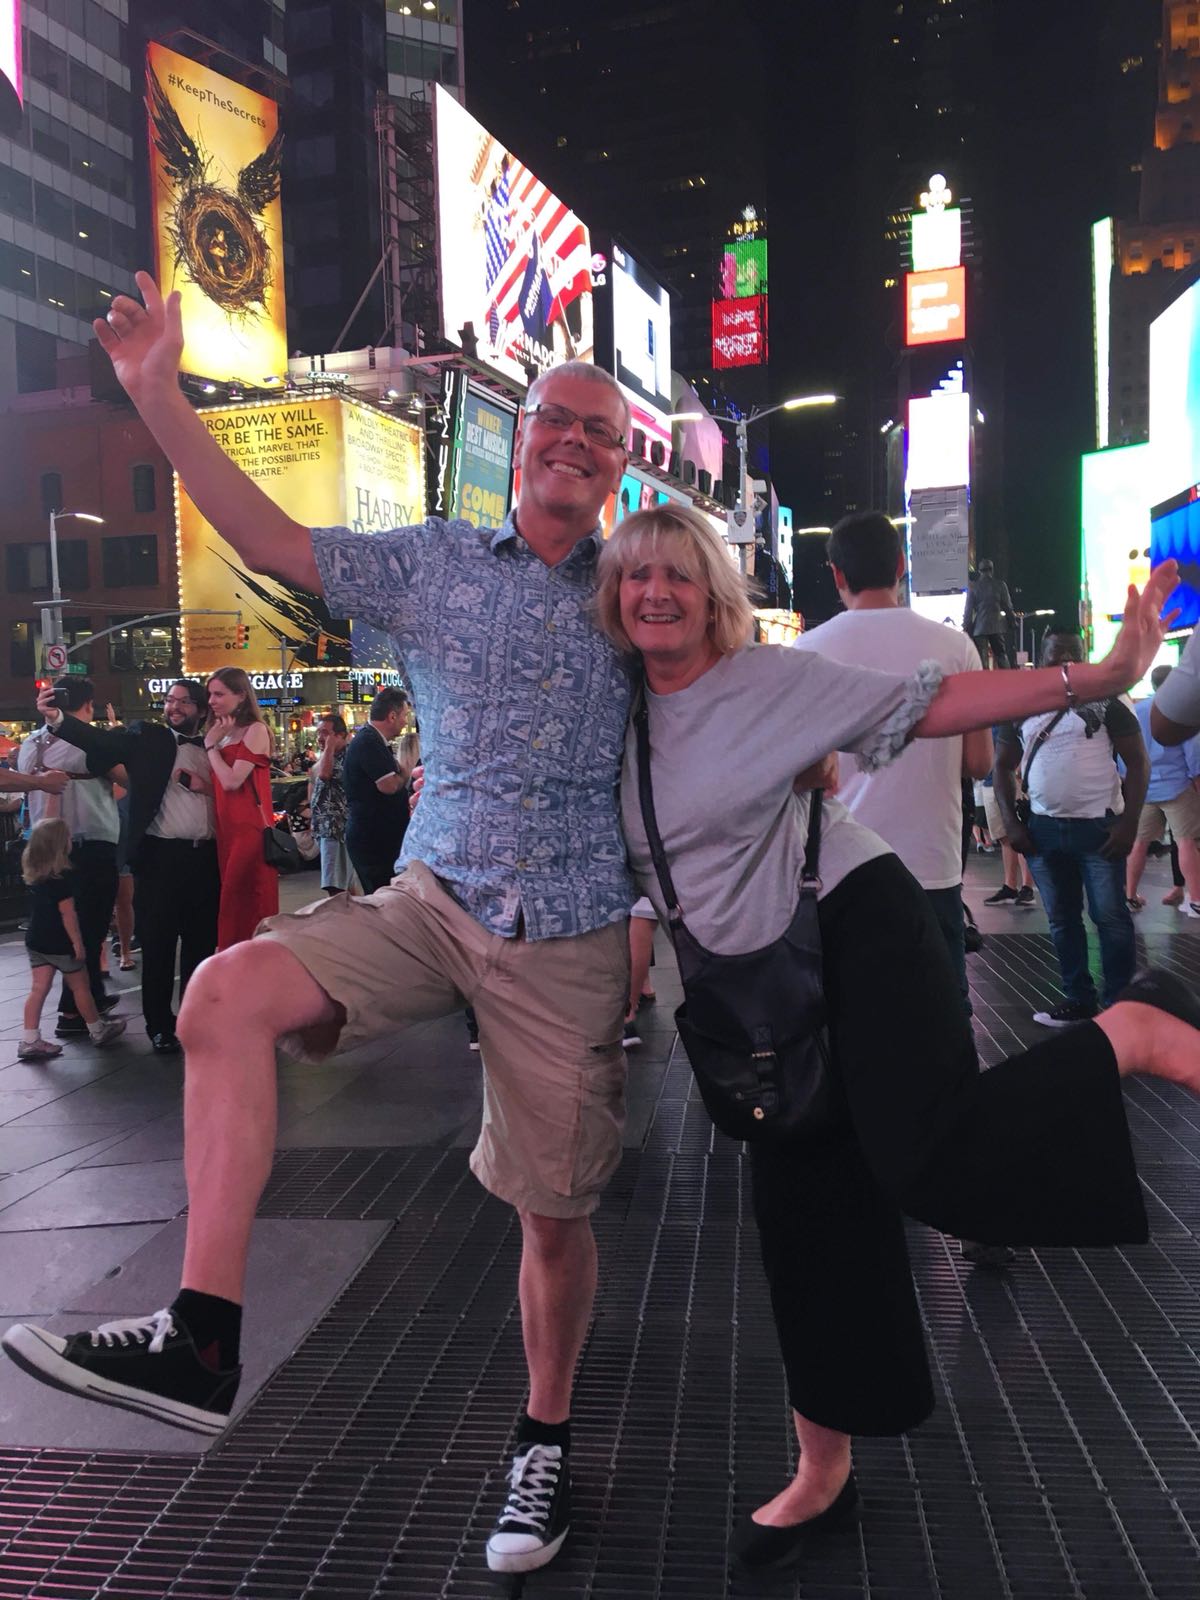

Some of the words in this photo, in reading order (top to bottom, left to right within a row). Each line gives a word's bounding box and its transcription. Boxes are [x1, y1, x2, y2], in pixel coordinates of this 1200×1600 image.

[167, 73, 266, 128] #KeepTheSecrets
[591, 273, 607, 287] LG
[205, 412, 276, 431] ROADWAY
[281, 408, 317, 423] WILL
[214, 433, 231, 446] ER
[234, 431, 251, 445] BE
[255, 427, 283, 442] THE
[287, 422, 328, 439] SAME.
[225, 446, 256, 457] TRICAL
[258, 442, 294, 454] MARVEL
[297, 439, 320, 449] THAT
[242, 458, 259, 467] THE
[261, 451, 321, 465] POSSIBILITIES
[355, 486, 414, 529] HARRY
[462, 483, 505, 521] COME
[247, 673, 304, 690] GAGE
[380, 671, 403, 687] LUGG
